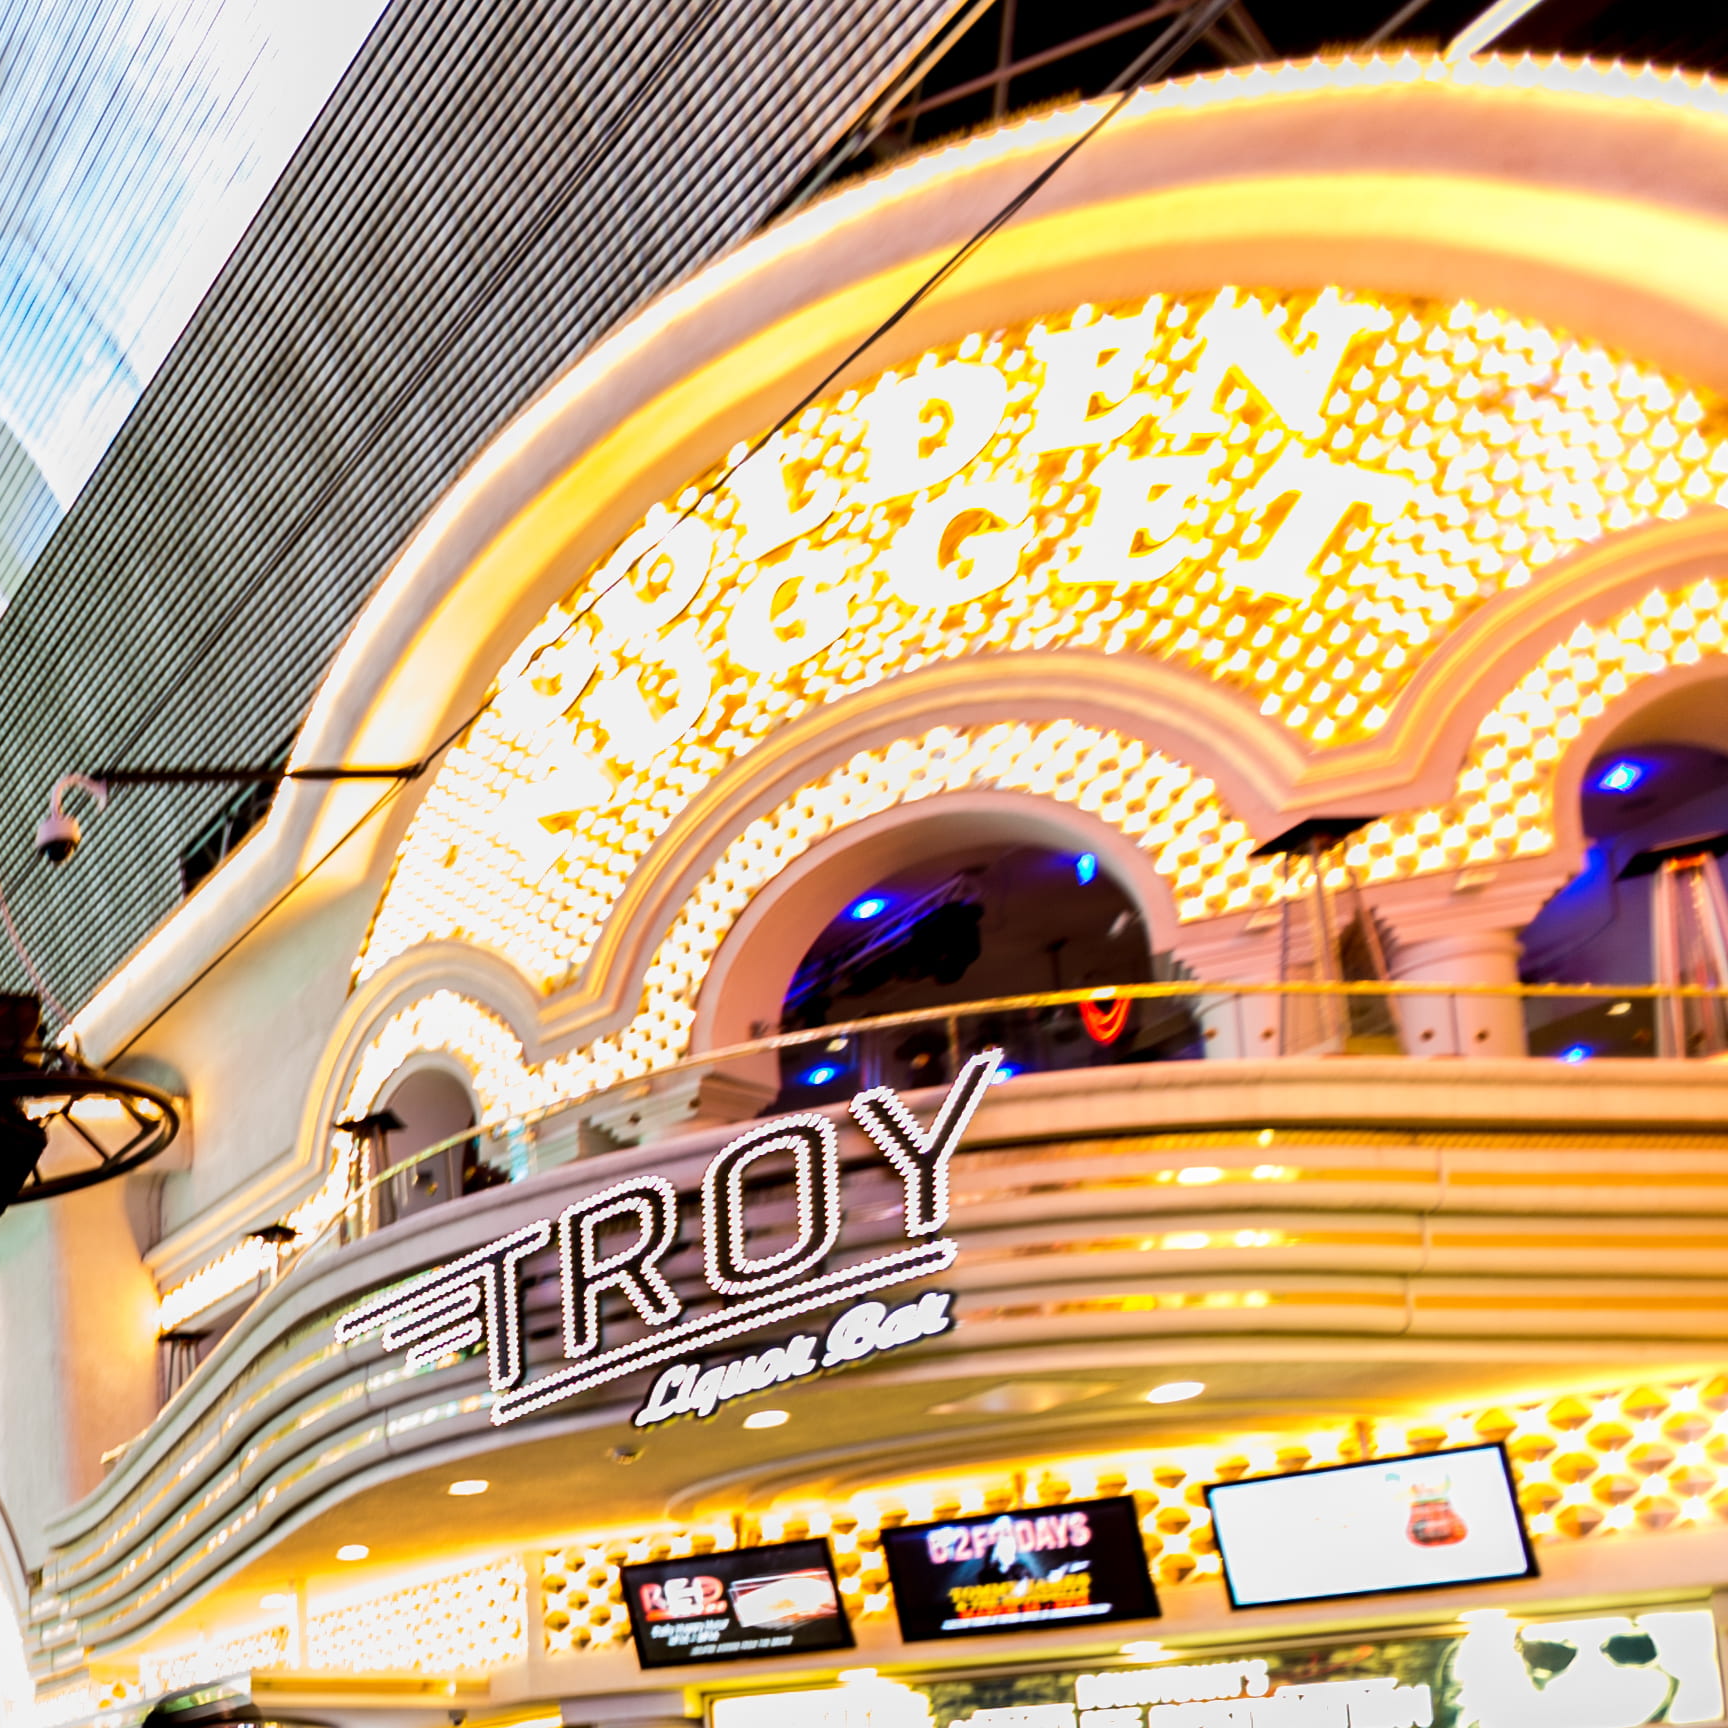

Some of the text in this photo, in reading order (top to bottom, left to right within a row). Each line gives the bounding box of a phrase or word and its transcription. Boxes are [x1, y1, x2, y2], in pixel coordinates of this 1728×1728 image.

[486, 450, 1424, 880] NUGGET
[492, 288, 1392, 735] GOLDEN
[334, 1046, 1004, 1391] TROY
[632, 1292, 951, 1426] Liquor Bar
